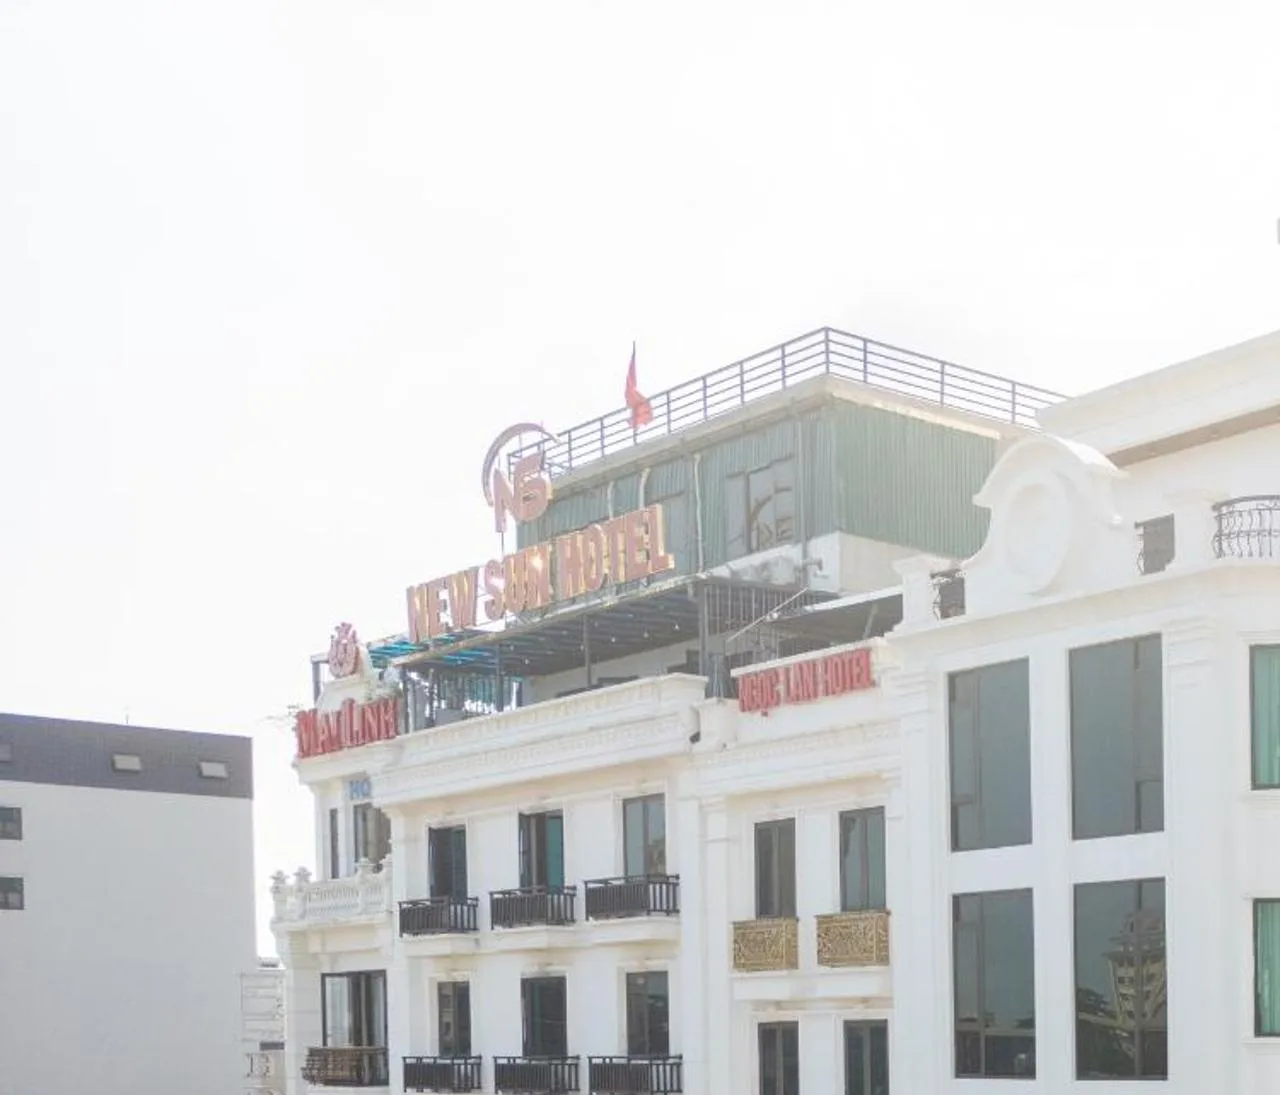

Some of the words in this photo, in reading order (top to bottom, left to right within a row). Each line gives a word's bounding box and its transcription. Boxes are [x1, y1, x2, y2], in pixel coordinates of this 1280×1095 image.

[406, 566, 479, 642] NEW
[483, 541, 553, 620] SUN
[557, 503, 675, 600] HOTEL
[782, 660, 819, 705] LAN
[822, 647, 876, 696] HOTEL
